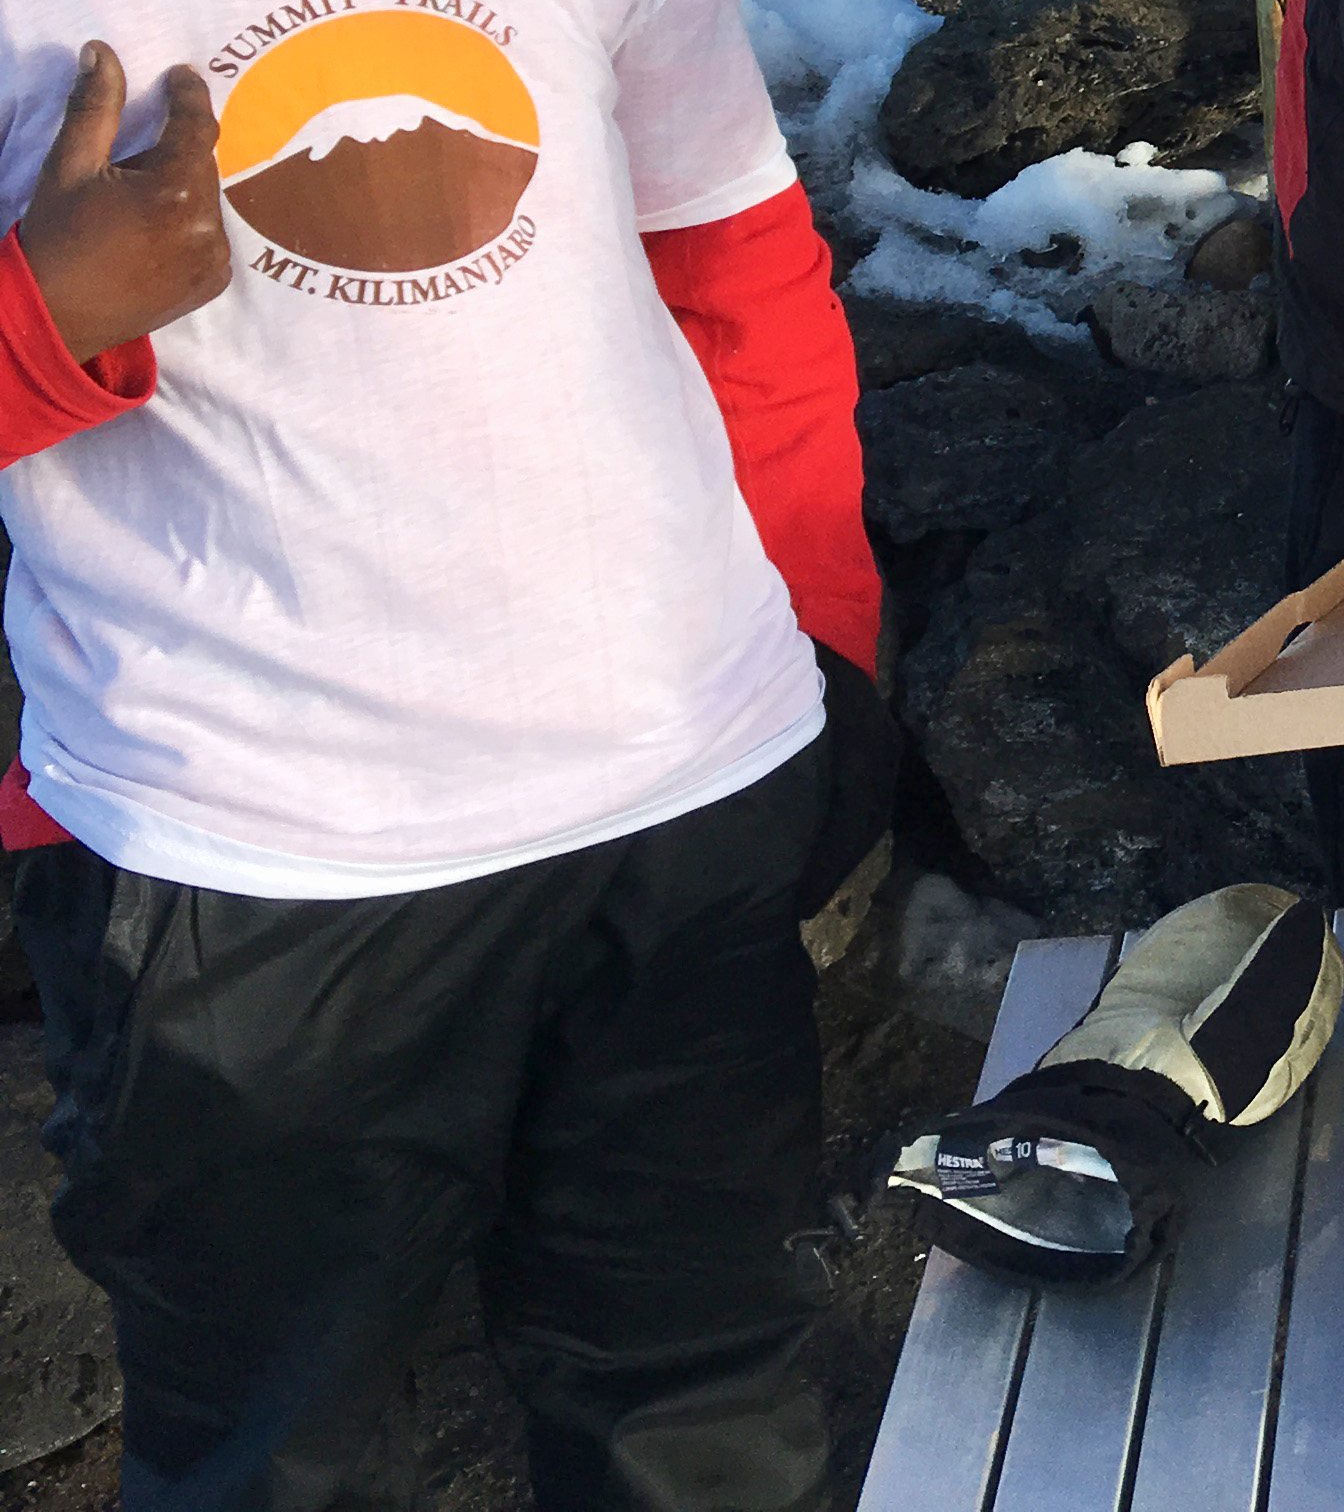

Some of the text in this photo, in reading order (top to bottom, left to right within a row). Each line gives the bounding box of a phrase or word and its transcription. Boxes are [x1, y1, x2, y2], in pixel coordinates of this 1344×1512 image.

[249, 214, 537, 306] MT. KILIMANJARO
[1015, 1141, 1031, 1159] 10
